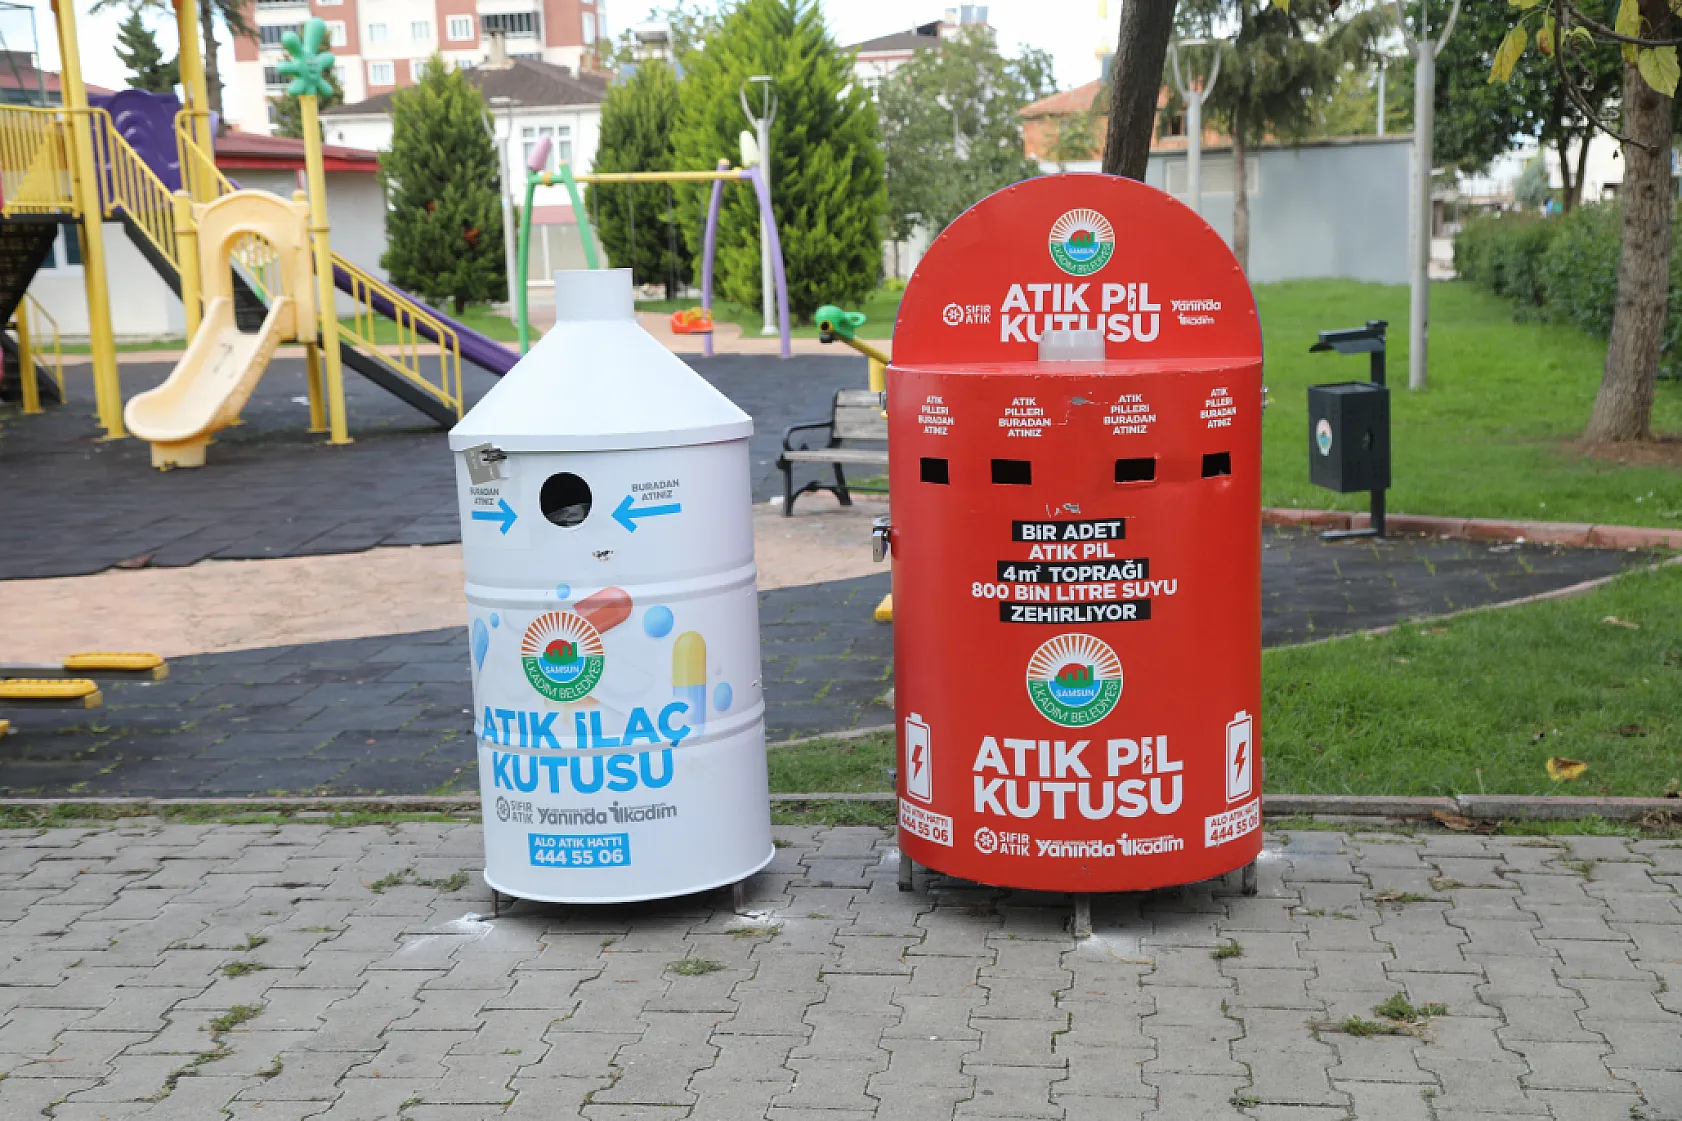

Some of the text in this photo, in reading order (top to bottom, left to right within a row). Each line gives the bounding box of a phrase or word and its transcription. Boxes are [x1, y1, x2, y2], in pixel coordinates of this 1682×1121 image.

[1000, 283, 1091, 312] ATIK
[965, 304, 991, 314] SIFIR
[966, 314, 991, 325] ATIK
[1211, 387, 1228, 397] ATIK
[1012, 397, 1036, 406] ATIK
[1118, 394, 1143, 403] ATIK
[1200, 407, 1237, 418] BURADAN
[918, 415, 954, 425] BURADAN
[998, 418, 1051, 427] BURADAN
[1103, 414, 1156, 425] BURADAN
[1007, 428, 1042, 437] ATINIZ
[1112, 425, 1148, 435] ATINIZ
[632, 479, 679, 492] BURADAN
[1062, 522, 1120, 540] ADET
[1028, 543, 1078, 560] ATIK
[1048, 559, 1143, 582] TOPRAĞI
[971, 581, 1009, 599] 800
[1122, 578, 1178, 598] SUYU
[545, 666, 579, 674] SAMSUN
[1055, 689, 1094, 697] SAMSUN
[482, 705, 562, 749] ATIK
[972, 735, 1092, 778] ATIK
[493, 748, 674, 794] KUTUSU
[973, 774, 1183, 820] KUTUSU
[510, 800, 533, 812] SIFIR
[511, 811, 533, 824] ATIK
[1211, 815, 1228, 827] ALO
[918, 821, 931, 837] 55
[933, 827, 949, 842] 06
[1210, 825, 1233, 841] 444
[1236, 818, 1248, 834] 55
[535, 836, 622, 848] ALO ATIK HATTI
[999, 831, 1030, 843] SIFIR
[1000, 843, 1030, 856] ATIK
[535, 849, 624, 865] 444 55 06
